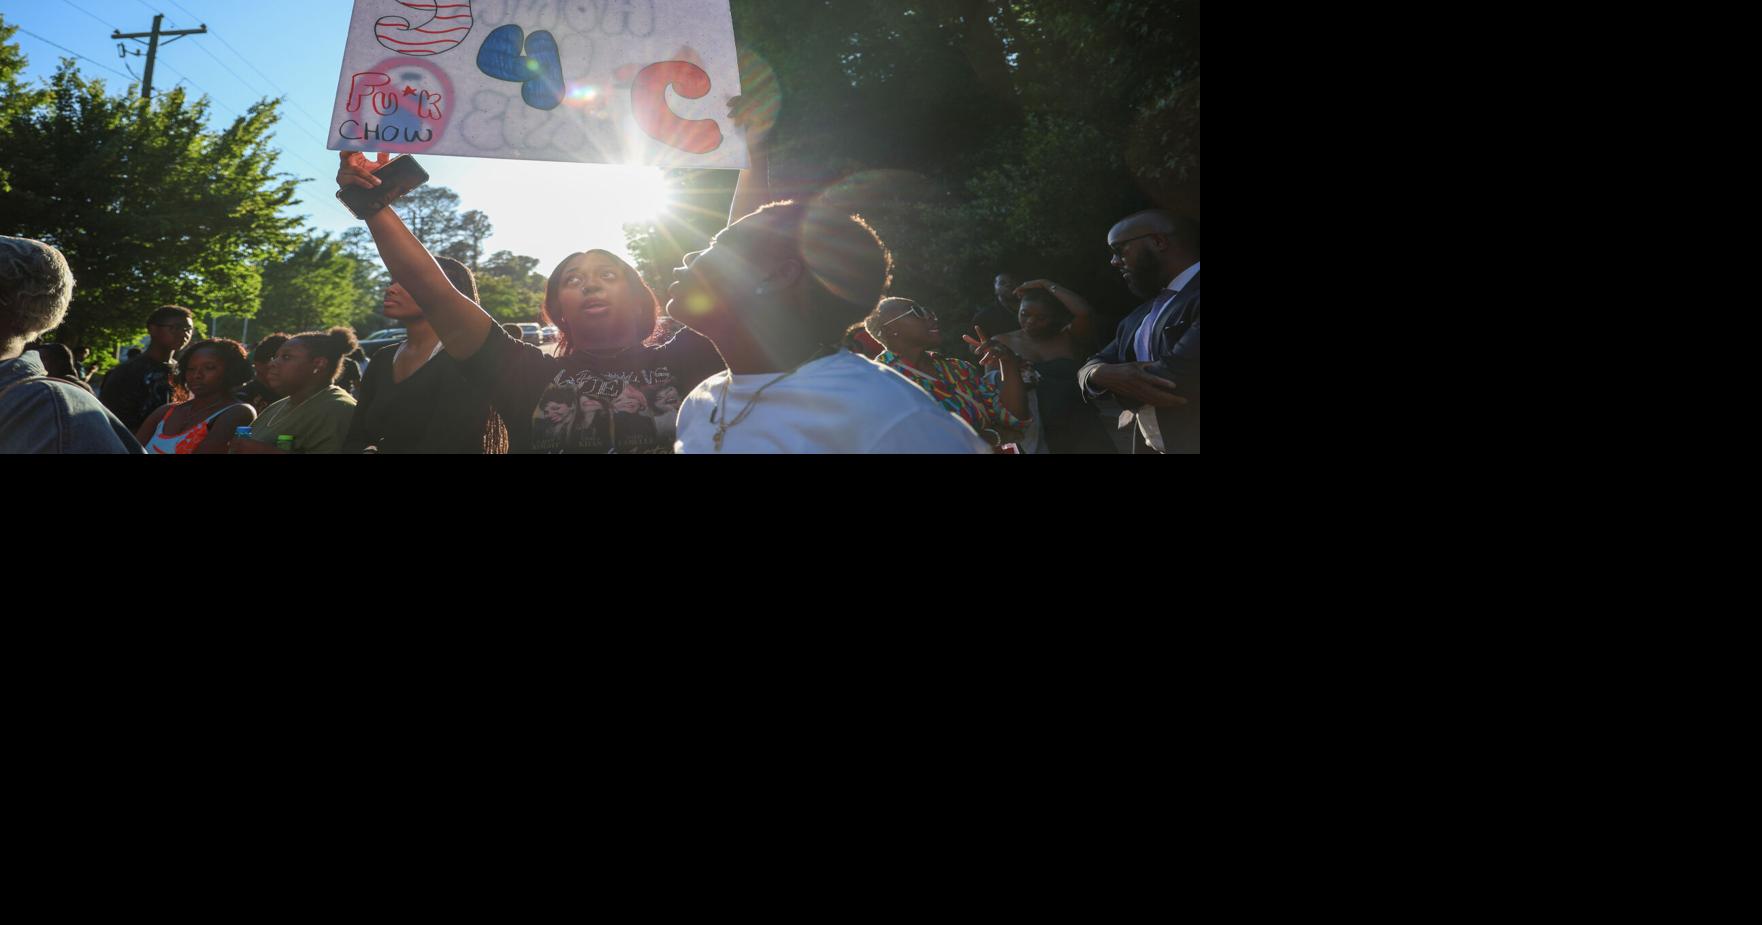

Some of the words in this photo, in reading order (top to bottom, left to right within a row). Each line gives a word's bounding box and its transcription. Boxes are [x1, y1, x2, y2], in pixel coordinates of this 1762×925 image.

[476, 24, 566, 111] 4
[631, 60, 724, 154] C
[339, 119, 433, 142] CHOW
